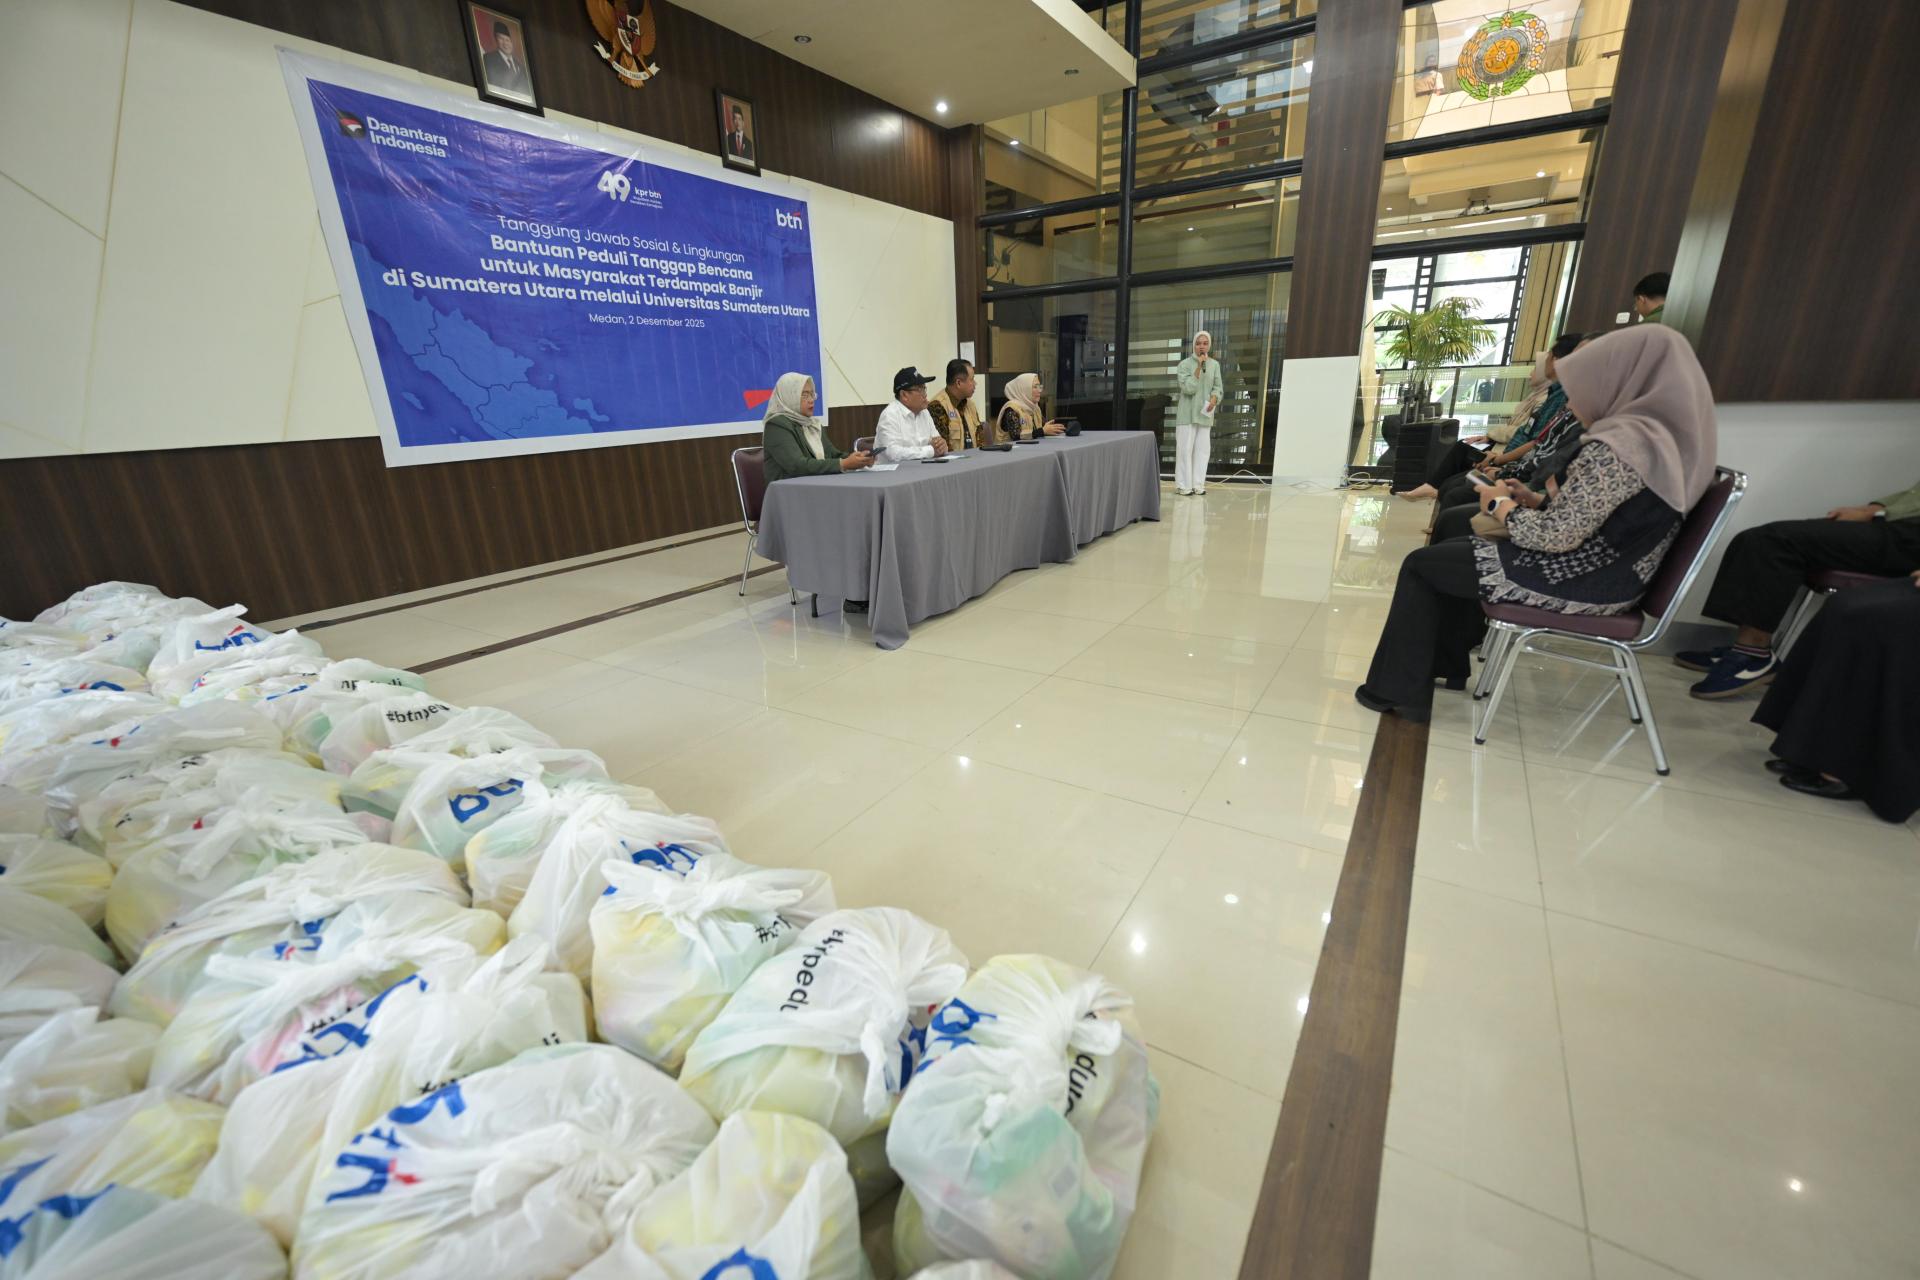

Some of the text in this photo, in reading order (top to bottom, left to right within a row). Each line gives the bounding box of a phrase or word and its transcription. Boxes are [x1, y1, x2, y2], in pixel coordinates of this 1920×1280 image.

[366, 116, 448, 146] Danantara
[370, 131, 446, 157] Indonesia
[597, 170, 631, 202] 49
[776, 208, 803, 230] btn
[497, 215, 745, 264] Tanggung Jawab Sosial & Lingkungan
[490, 234, 753, 281] Bantuan Peduli Tanggap Bencana
[382, 268, 810, 318] di Sumatera Utara melalui Universitas Sumatera Utara
[480, 257, 763, 301] untuk Masyarakat Terdampak Banjir
[588, 313, 705, 328] Medan, 2 Desember 2025
